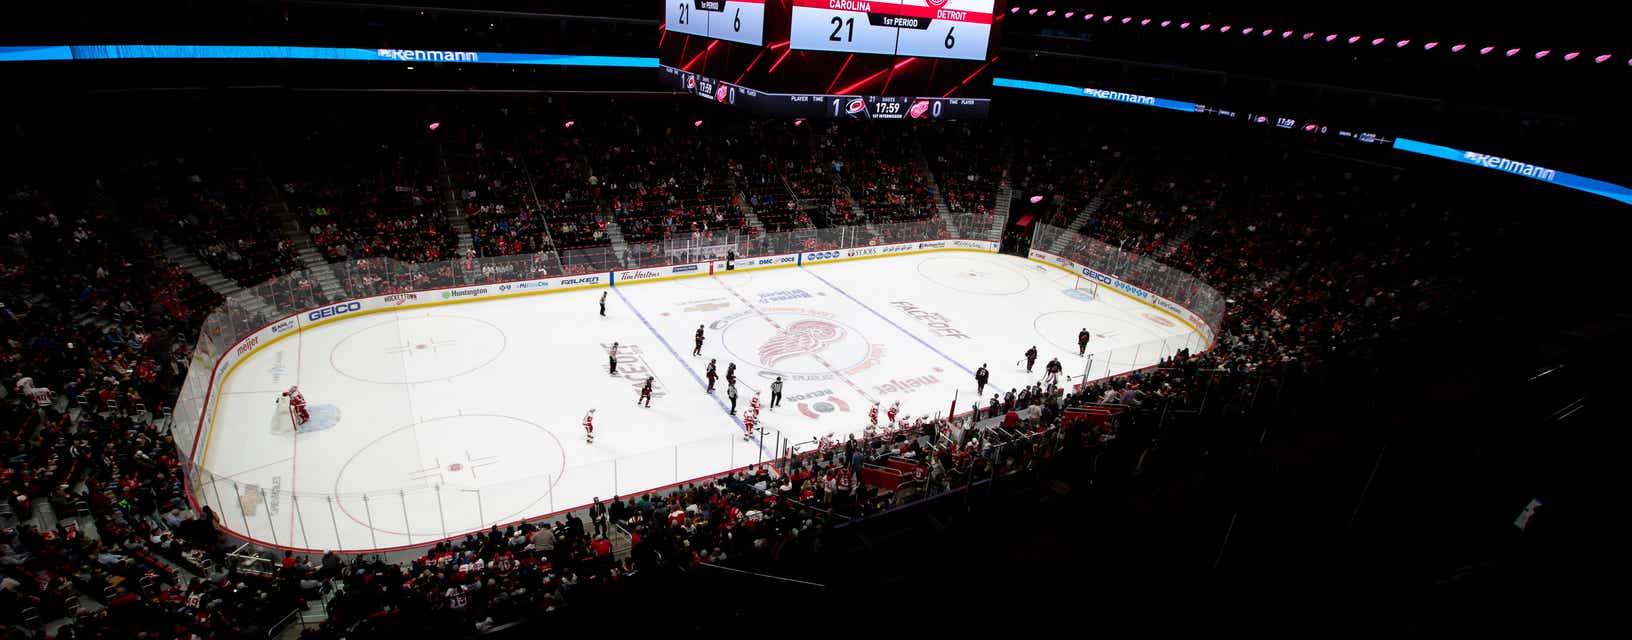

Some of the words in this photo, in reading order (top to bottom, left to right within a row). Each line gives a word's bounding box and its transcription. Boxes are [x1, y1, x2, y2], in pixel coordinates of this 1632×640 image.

[829, 0, 871, 12] CAROLINA
[679, 3, 689, 25] 21
[734, 7, 741, 33] 6
[937, 9, 967, 21] DETROIT
[829, 16, 855, 43] 21
[894, 17, 918, 27] PERIOD
[944, 26, 955, 50] 6
[833, 98, 840, 117] 1
[876, 102, 900, 113] 17:59
[932, 100, 941, 117] 0
[560, 276, 600, 286] FALKEN
[620, 272, 634, 281] Tim
[634, 269, 661, 280] Hortons
[1082, 267, 1112, 285] GEICO
[451, 287, 488, 298] Huntington
[308, 301, 362, 322] GEICO
[785, 388, 834, 402] BELFOR
